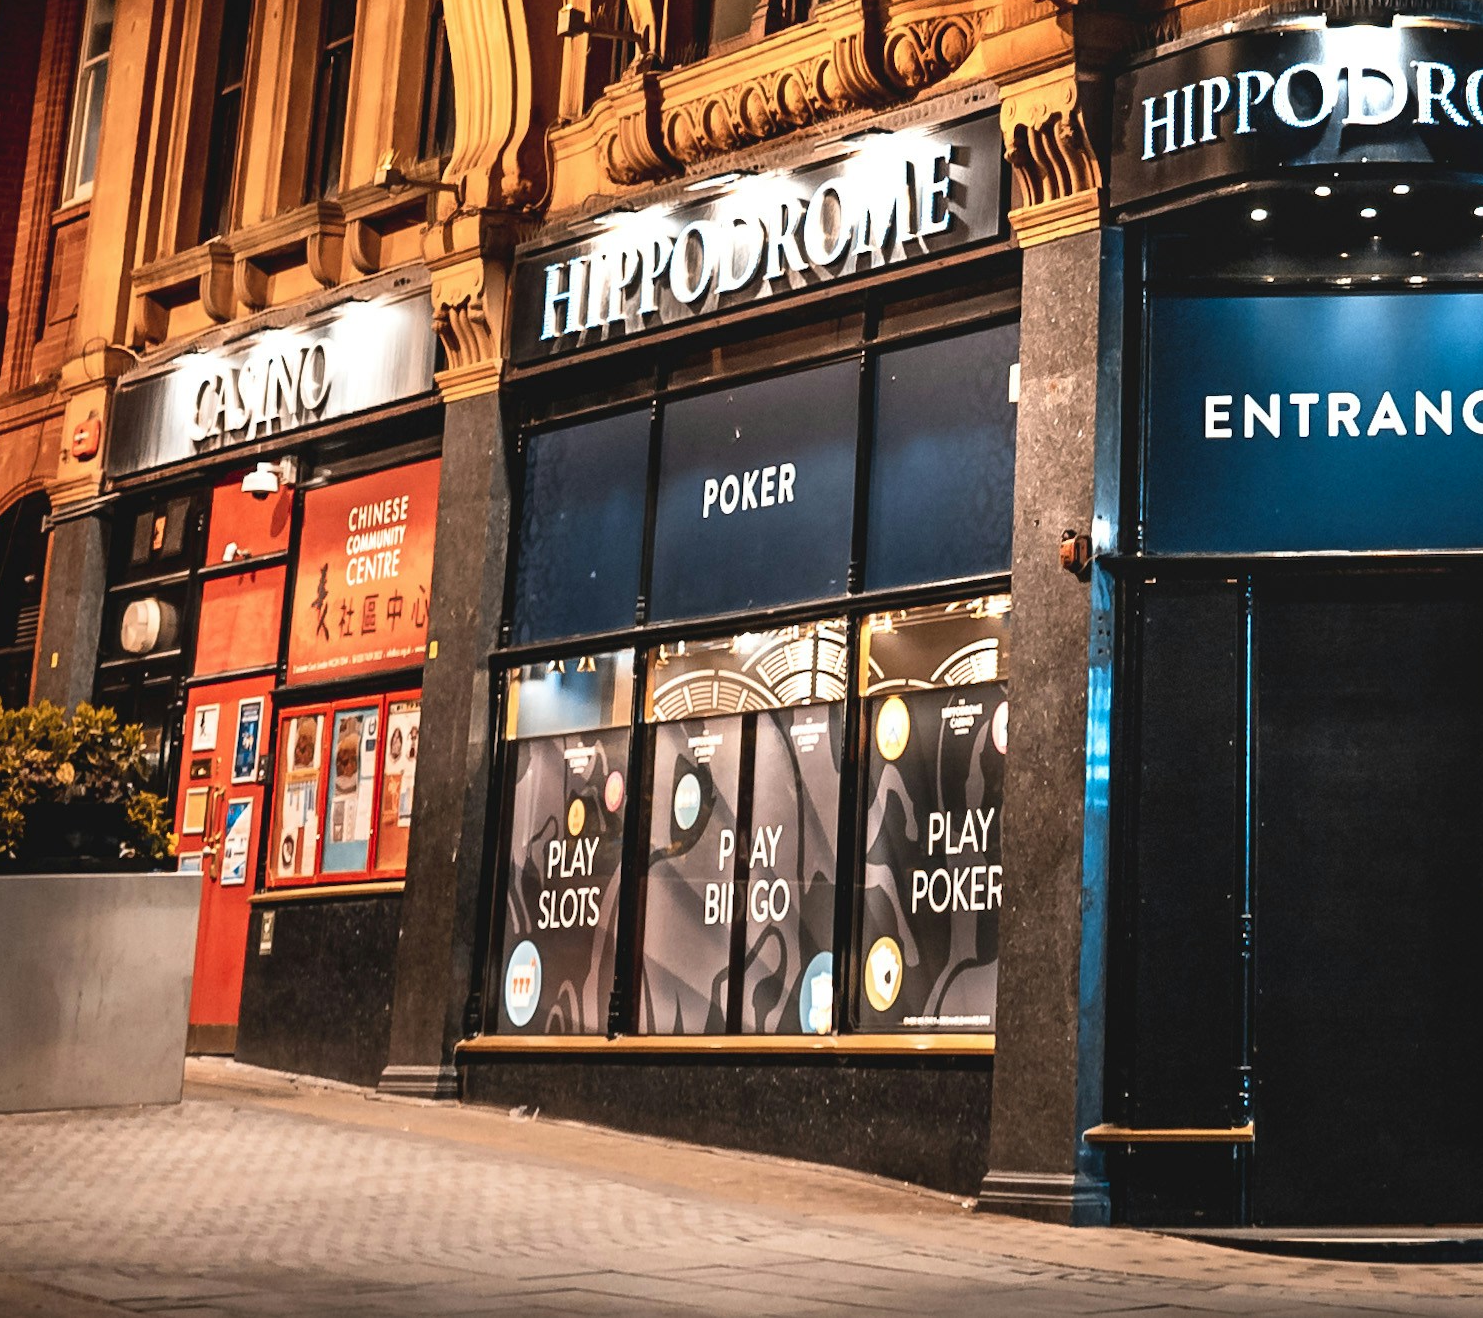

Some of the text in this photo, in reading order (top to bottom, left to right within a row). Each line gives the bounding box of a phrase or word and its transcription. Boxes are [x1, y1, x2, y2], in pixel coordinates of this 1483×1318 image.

[540, 143, 952, 340] HIPPODROME
[189, 338, 331, 441] CASINO
[703, 462, 796, 518] POKER
[348, 495, 409, 532] CHINESE
[346, 524, 406, 556] COMMUNITY
[346, 549, 401, 586] CENTRE
[719, 825, 783, 871] PAY
[928, 807, 995, 855] PLAY
[547, 837, 599, 879] PLAY
[537, 887, 601, 929] SLOTS
[912, 865, 1003, 913] POKER
